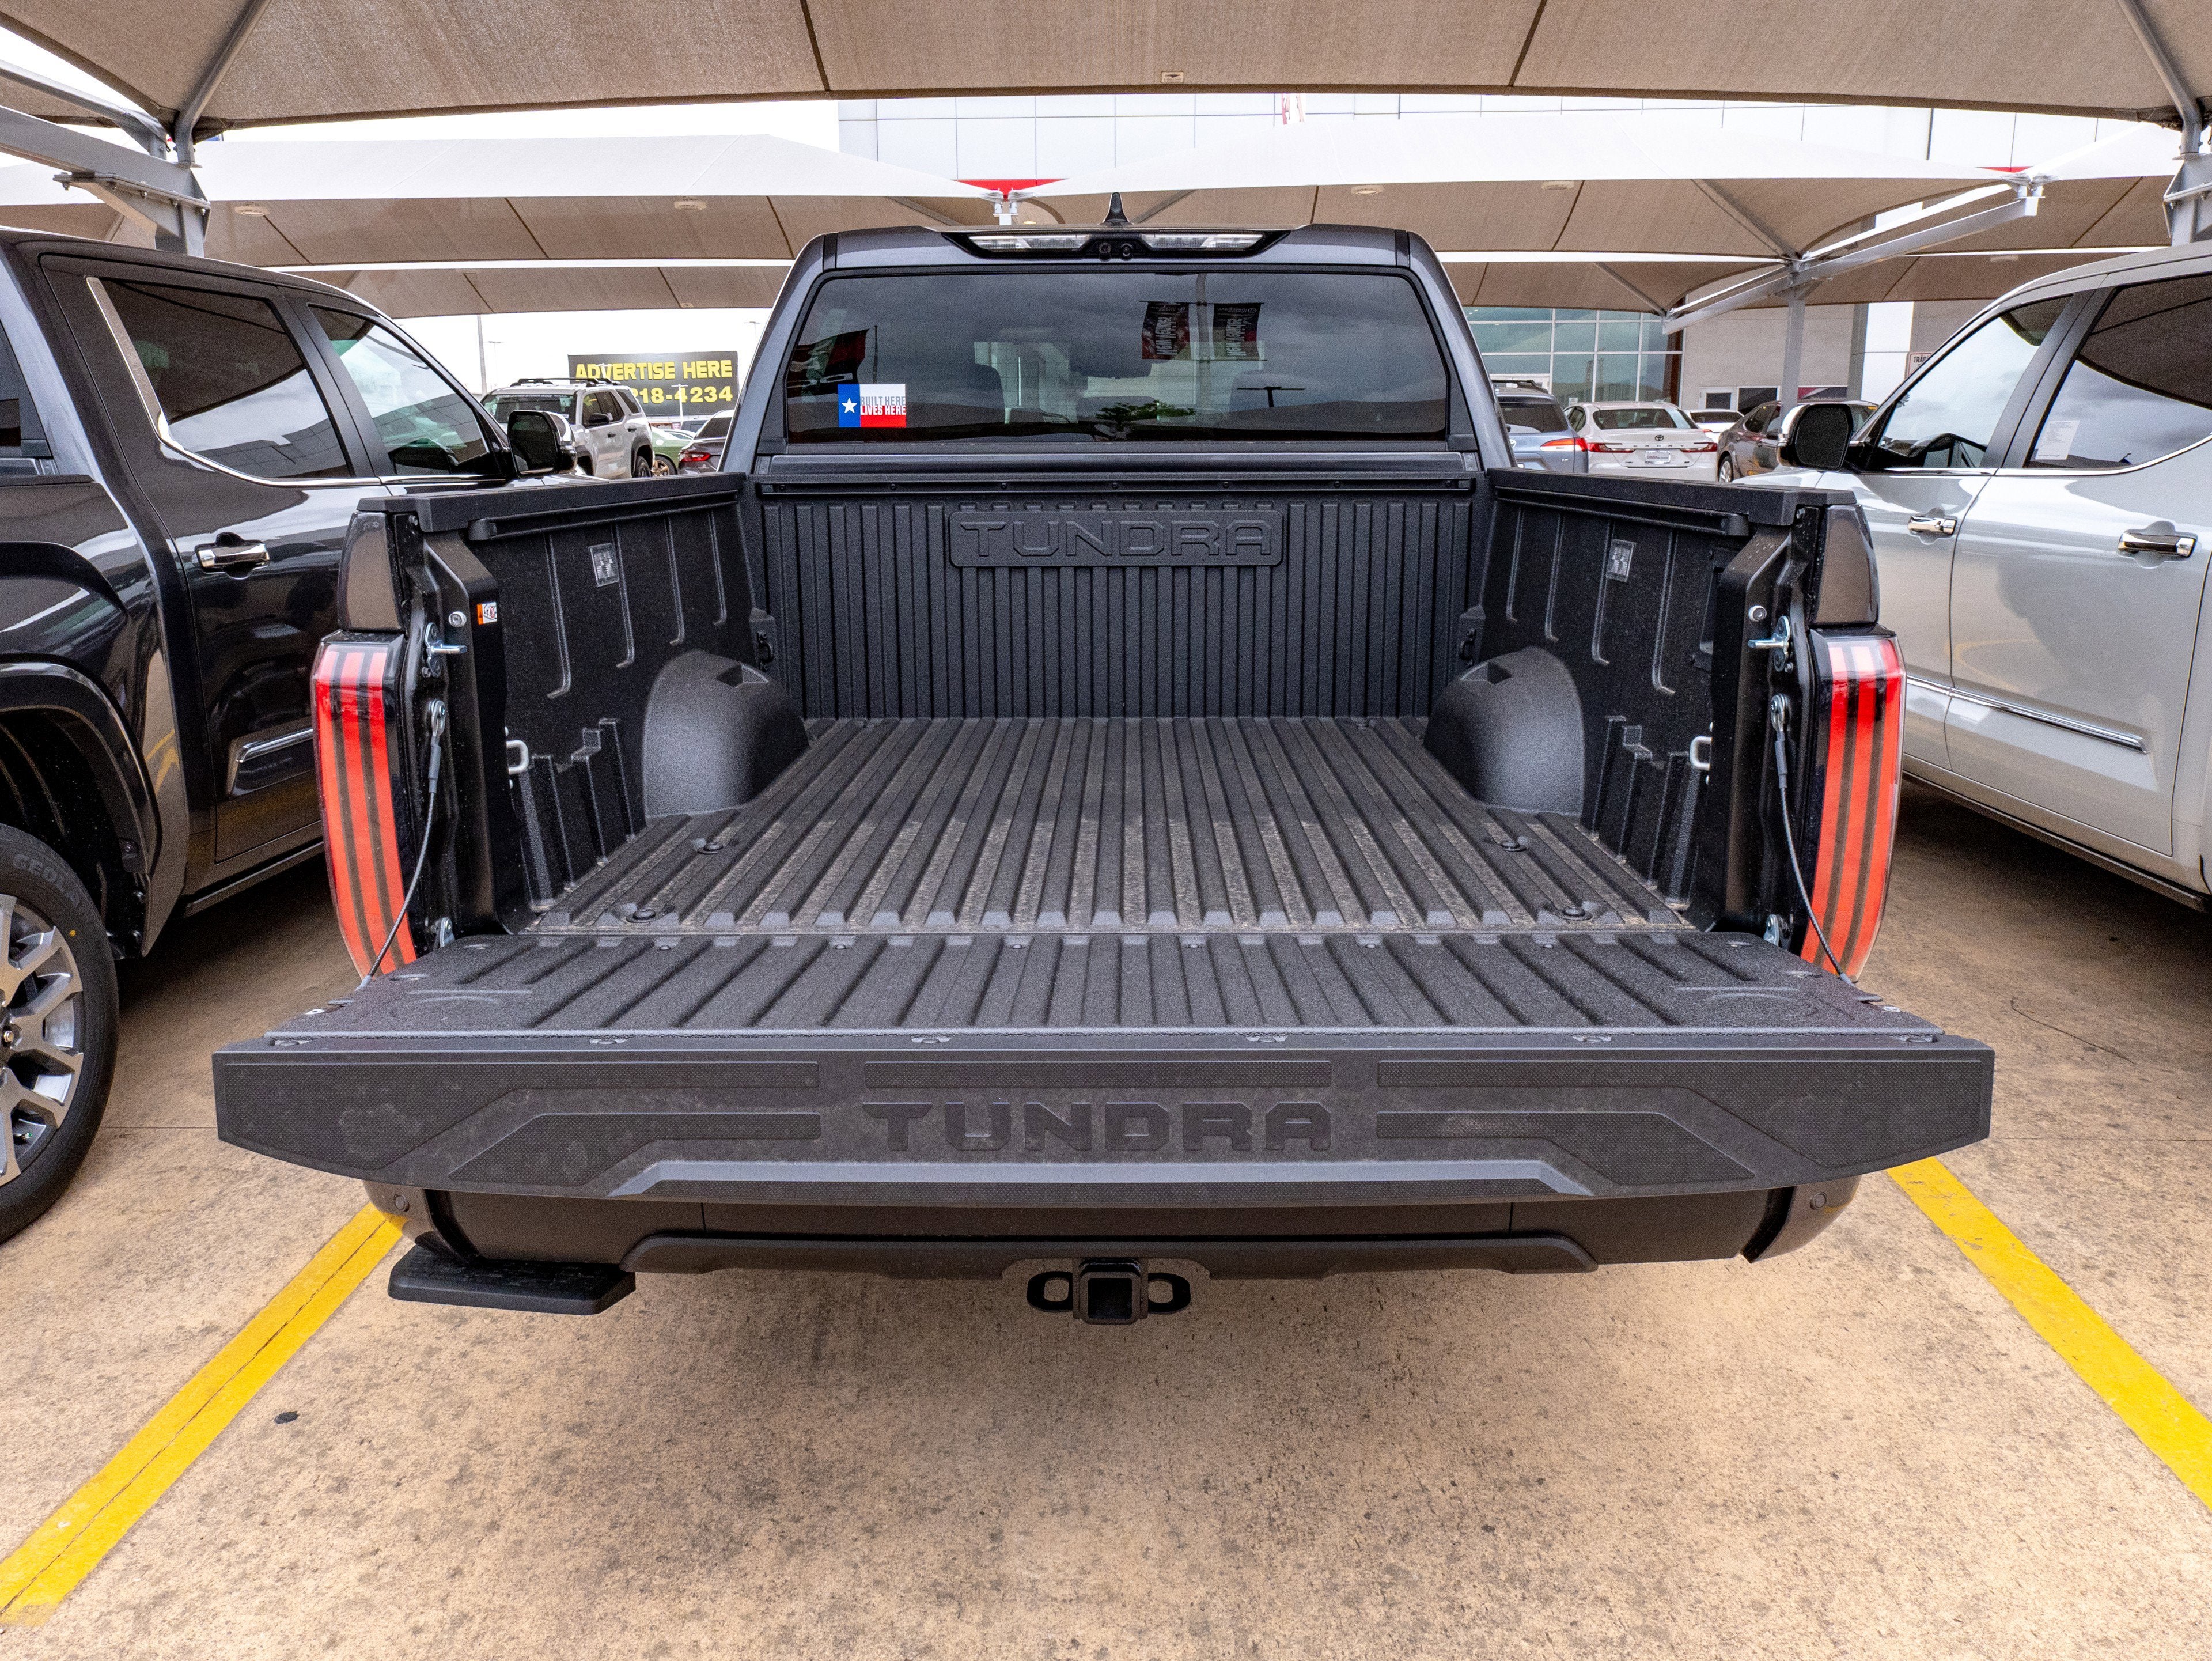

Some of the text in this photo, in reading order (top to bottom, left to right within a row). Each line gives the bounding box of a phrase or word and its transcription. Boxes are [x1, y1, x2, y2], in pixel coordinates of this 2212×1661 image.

[575, 360, 733, 381] ADVERTISE HERE
[861, 396, 906, 406] BUILT HERE
[861, 406, 906, 415] LIVES HERE
[960, 520, 1272, 557] TUNDRA
[861, 1100, 1332, 1152] TUNDRA
